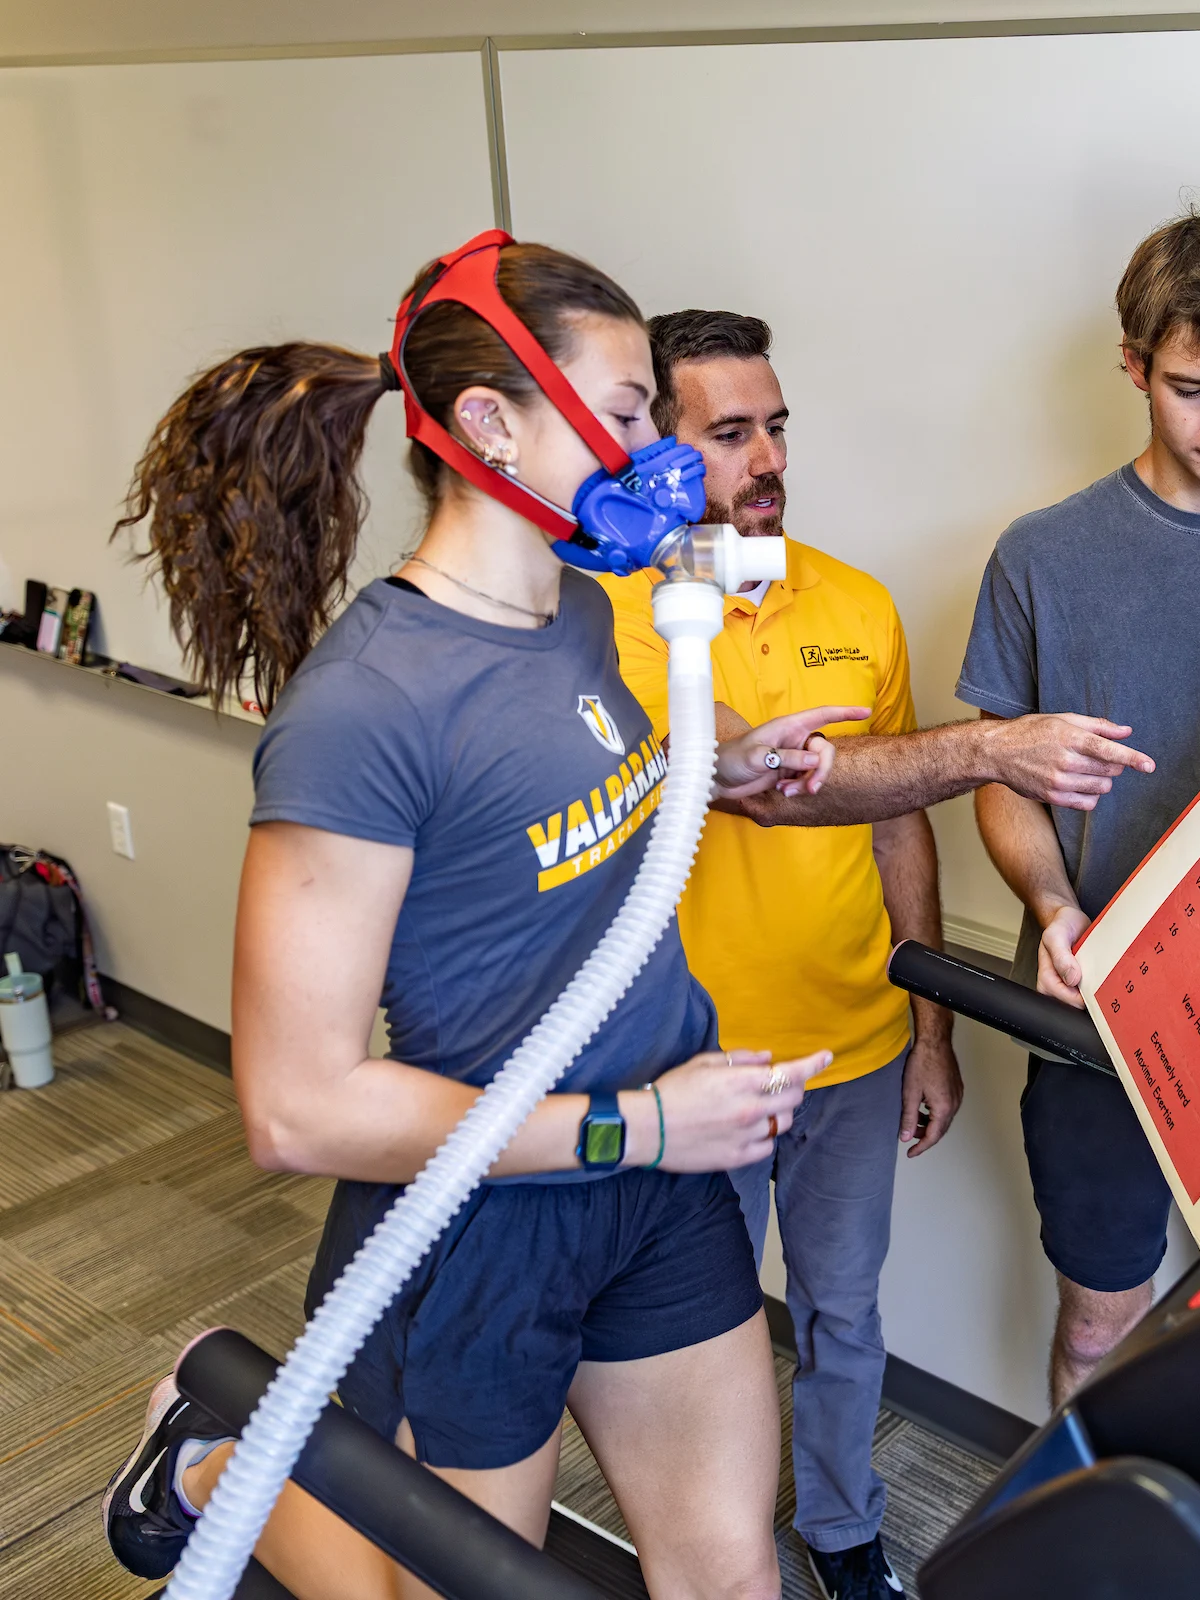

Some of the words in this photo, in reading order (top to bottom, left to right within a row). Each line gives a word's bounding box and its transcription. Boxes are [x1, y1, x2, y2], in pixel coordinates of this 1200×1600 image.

[572, 818, 633, 874] TRACK
[1168, 922, 1179, 937] 16
[1184, 903, 1195, 917] 15
[1139, 961, 1149, 975] 18
[1153, 942, 1164, 955] 17
[1182, 993, 1196, 1020] Very
[1110, 999, 1121, 1014] 20
[1133, 1048, 1157, 1088] Maximal
[1152, 1086, 1175, 1131] Exertion
[1125, 980, 1135, 994] 19
[1150, 1031, 1176, 1082] Extremely
[1174, 1079, 1191, 1108] Hard
